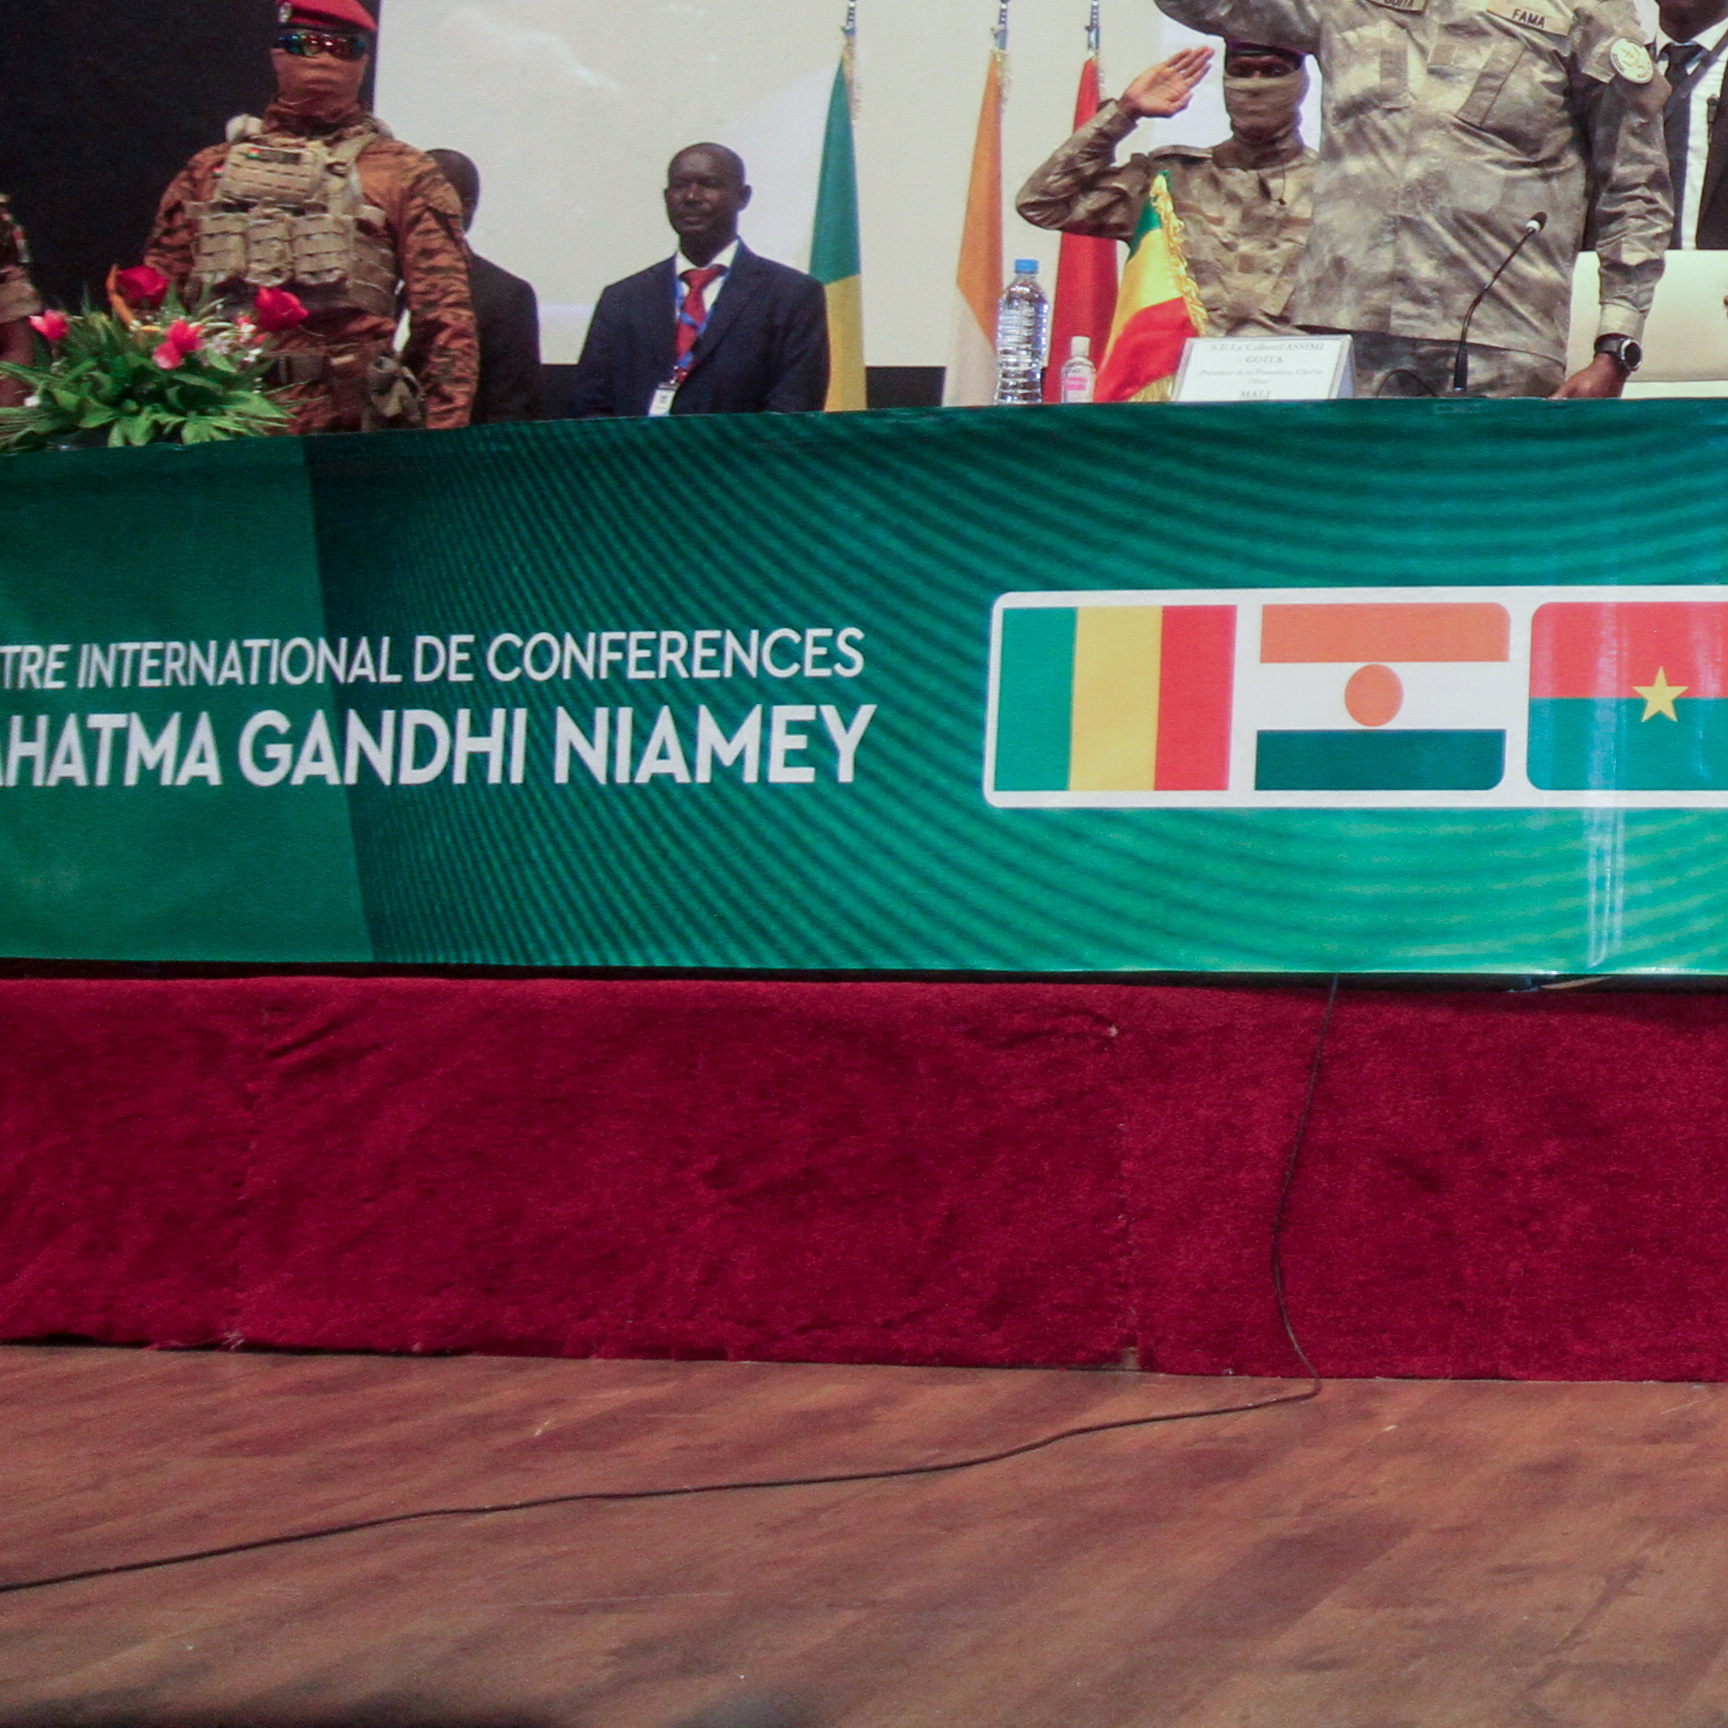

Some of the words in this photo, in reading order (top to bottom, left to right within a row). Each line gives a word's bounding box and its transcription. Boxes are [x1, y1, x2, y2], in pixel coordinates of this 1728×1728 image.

[1512, 8, 1547, 29] FAMA
[1286, 342, 1325, 351] ASSIMI
[1245, 355, 1283, 364] GOITA
[76, 636, 403, 689] INTERNATIONAL
[413, 634, 474, 683] DE
[485, 627, 865, 682] CONFERENCES
[0, 712, 223, 787] HATMA
[238, 708, 527, 787] GANDHI
[554, 703, 877, 784] NIAMEY
